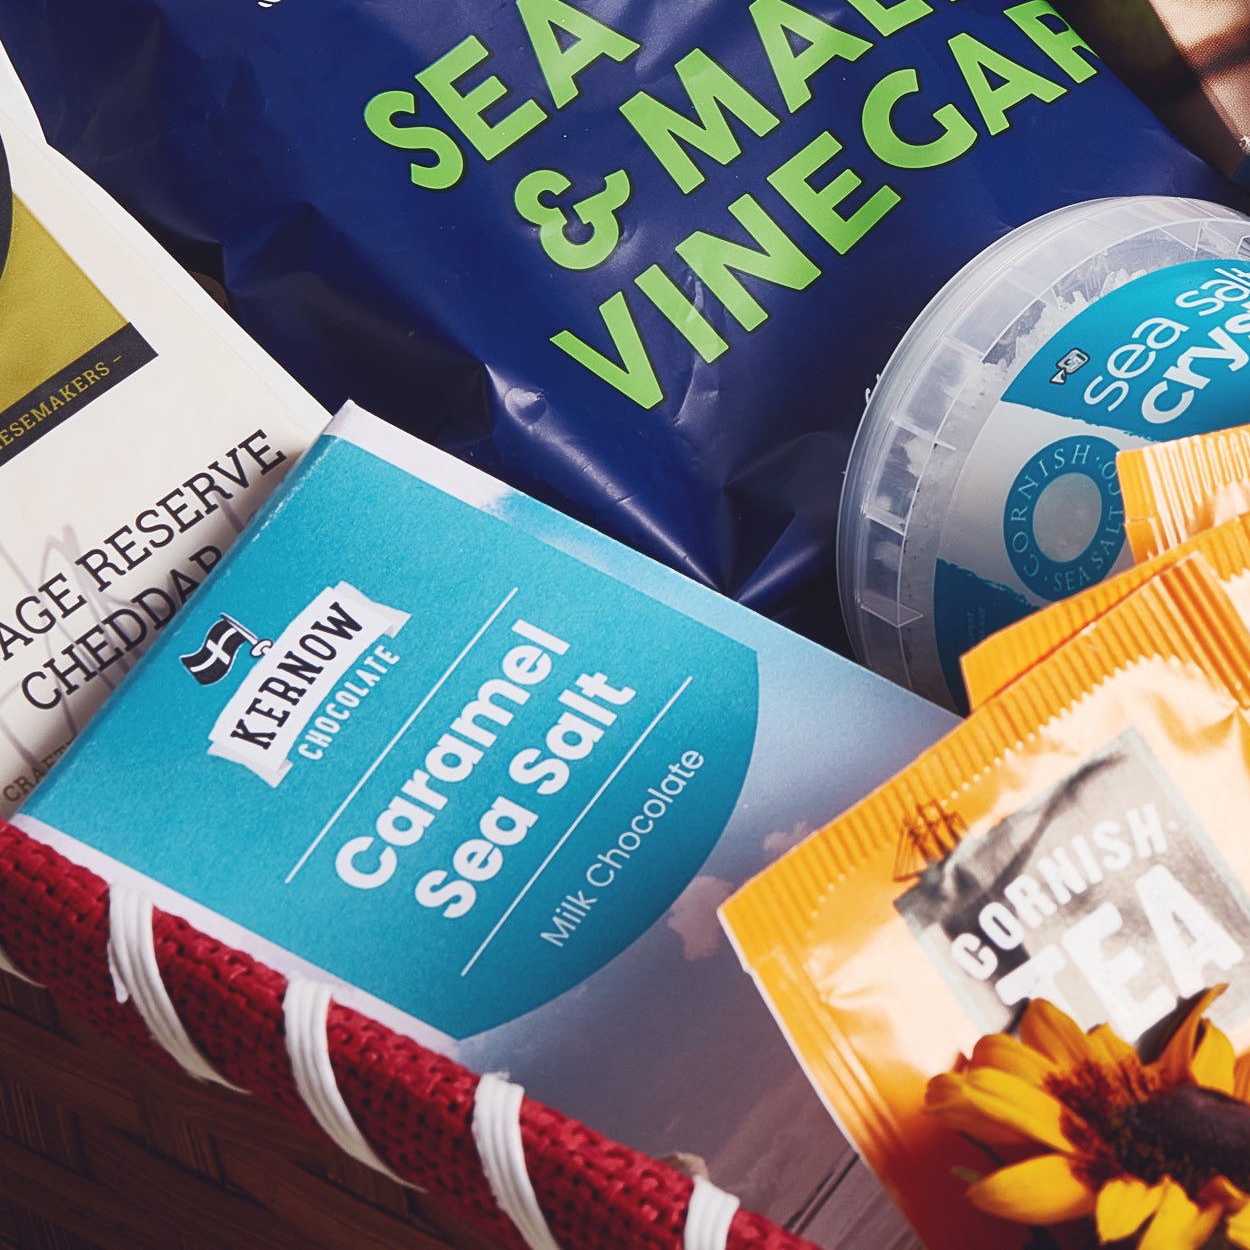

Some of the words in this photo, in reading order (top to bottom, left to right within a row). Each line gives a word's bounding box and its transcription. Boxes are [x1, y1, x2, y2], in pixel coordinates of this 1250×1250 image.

[513, 167, 631, 269] &
[548, 0, 1099, 409] VINEGAR
[0, 361, 110, 450] ESEMAKERS
[1083, 315, 1189, 412] sea
[74, 428, 287, 592] RESERVE
[1010, 444, 1091, 577] CORNISH
[1053, 565, 1091, 591] SEA
[1091, 505, 1124, 570] SALT
[230, 601, 364, 751] KERNOW
[298, 644, 401, 761] CHOCOLATE
[335, 618, 571, 890] Caramel
[414, 795, 539, 919] Sea
[509, 671, 637, 795] Salt
[540, 891, 598, 947] Milk
[586, 748, 705, 888] Chocolate
[951, 802, 1168, 981] CORNISH
[994, 864, 1245, 1042] TEA
